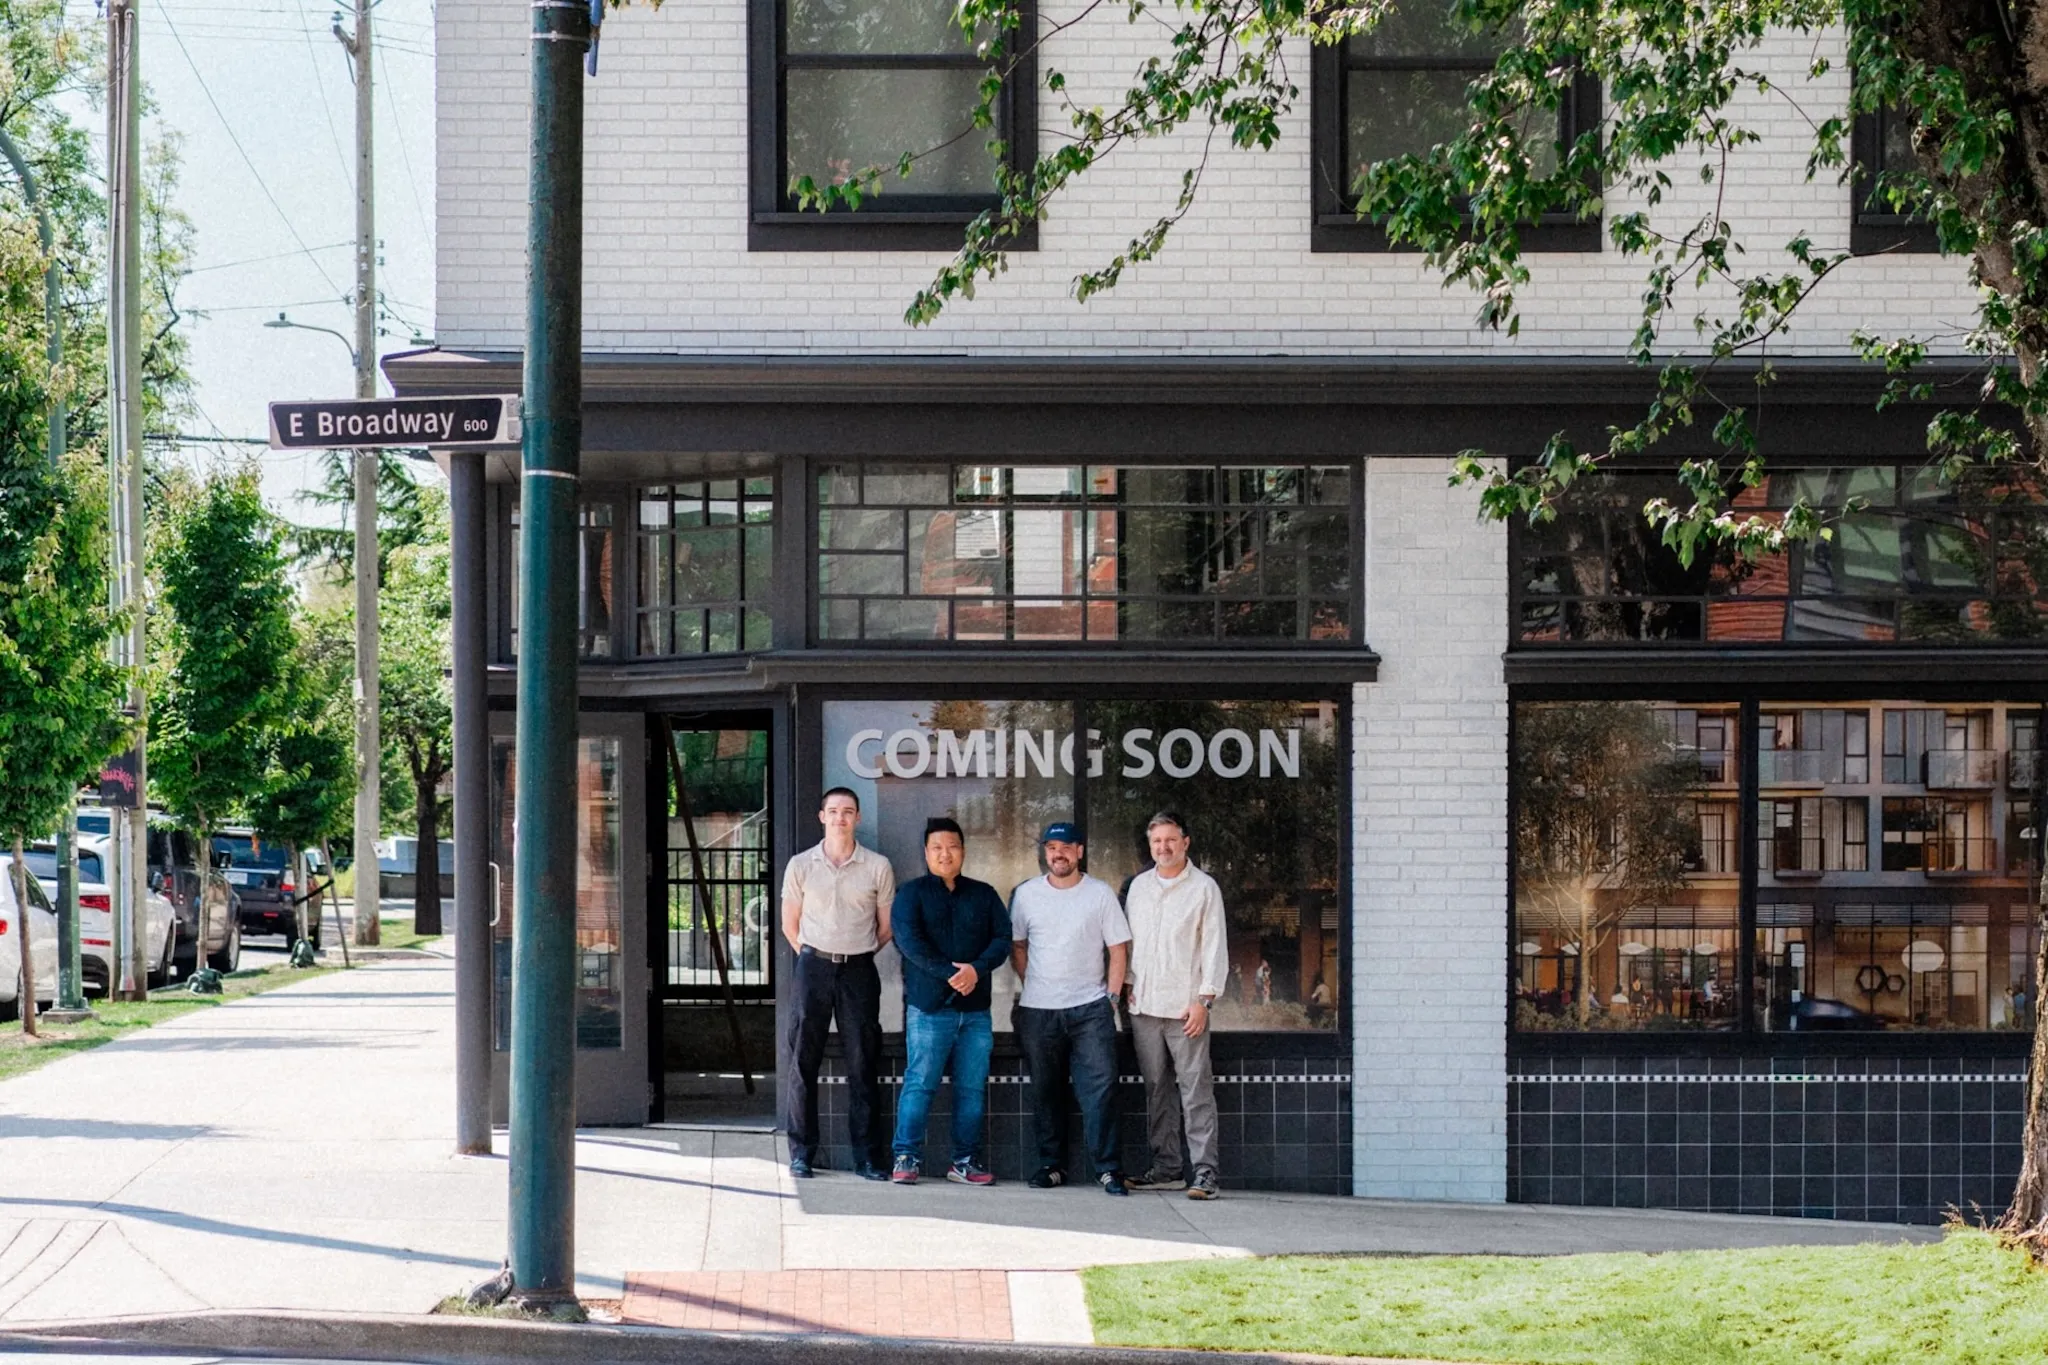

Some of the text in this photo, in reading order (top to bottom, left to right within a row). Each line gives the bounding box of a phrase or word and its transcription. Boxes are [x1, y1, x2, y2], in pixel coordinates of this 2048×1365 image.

[289, 408, 489, 439] E Broadway 600
[845, 728, 1300, 778] COMING SOON
